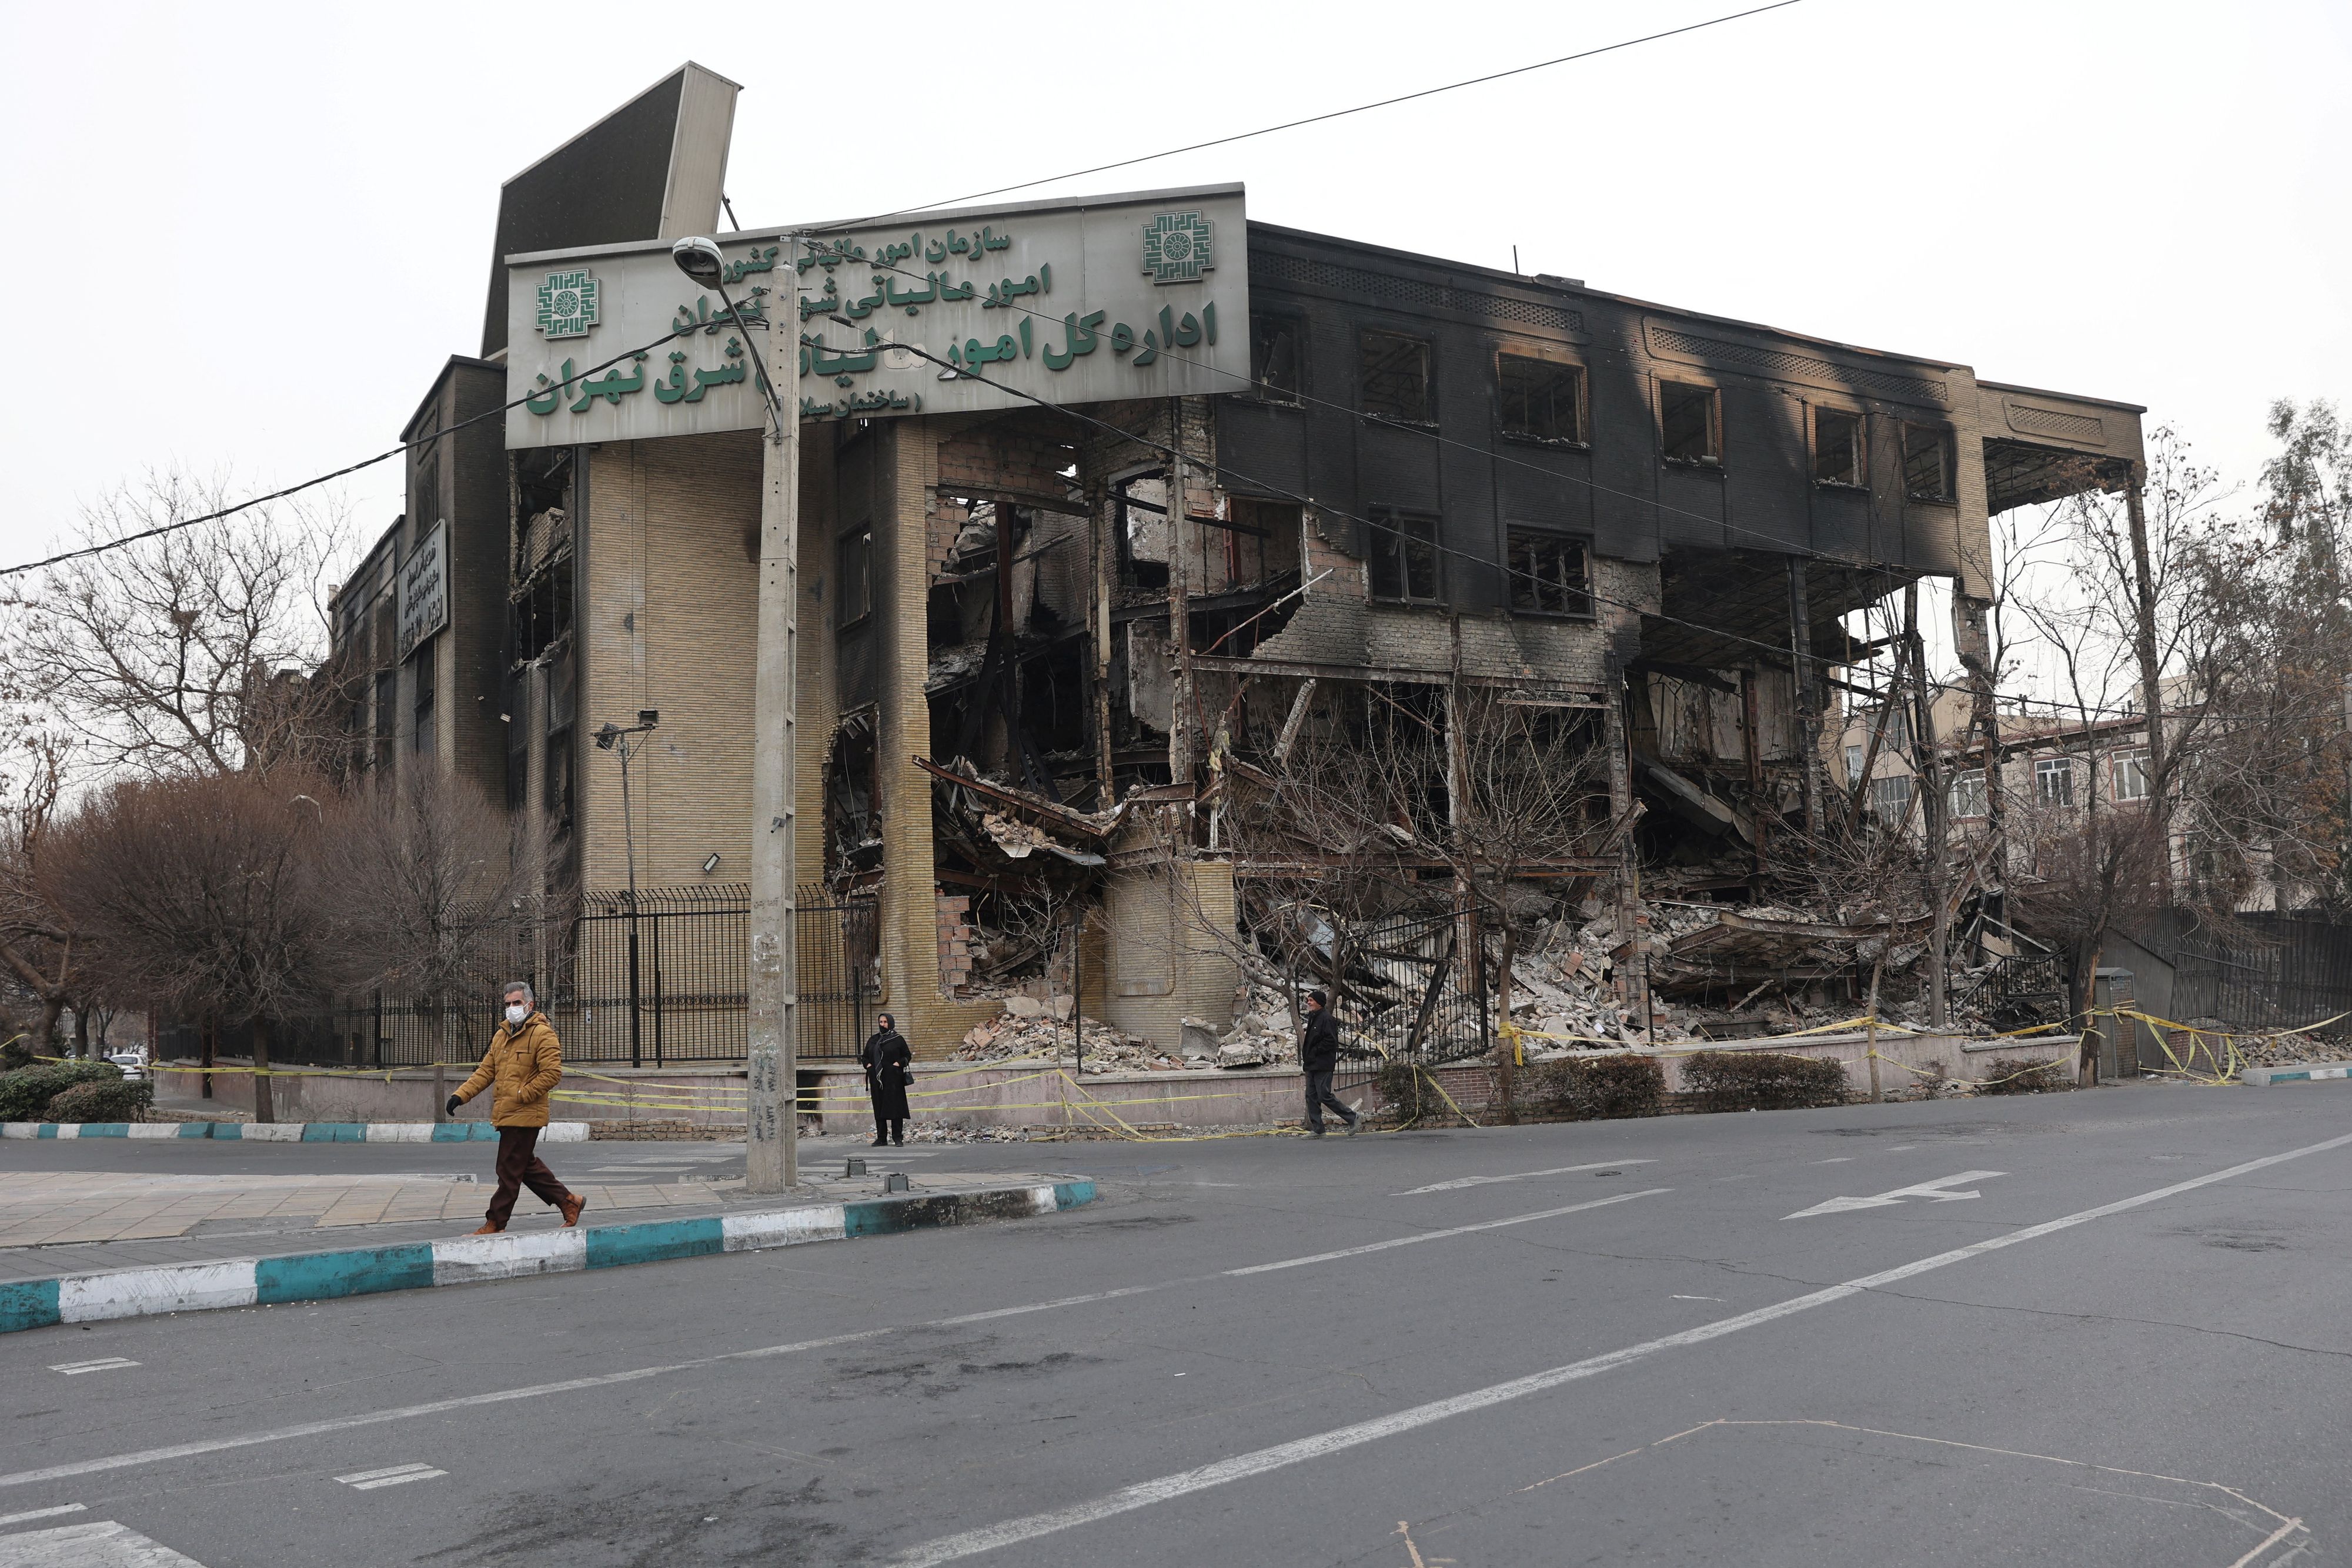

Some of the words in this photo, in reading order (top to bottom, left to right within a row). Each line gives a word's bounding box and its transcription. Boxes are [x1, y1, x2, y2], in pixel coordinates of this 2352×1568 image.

[724, 246, 779, 283] کشور
[870, 232, 920, 269] امور
[926, 226, 1010, 263] سازمان
[800, 276, 838, 321] شه
[846, 270, 974, 318] مالیاتی
[982, 262, 1051, 309] امور
[937, 315, 1033, 381] امور
[1043, 309, 1105, 371] کل
[1111, 300, 1217, 366] اداره
[526, 350, 649, 415] تهران
[654, 336, 747, 403] شرق
